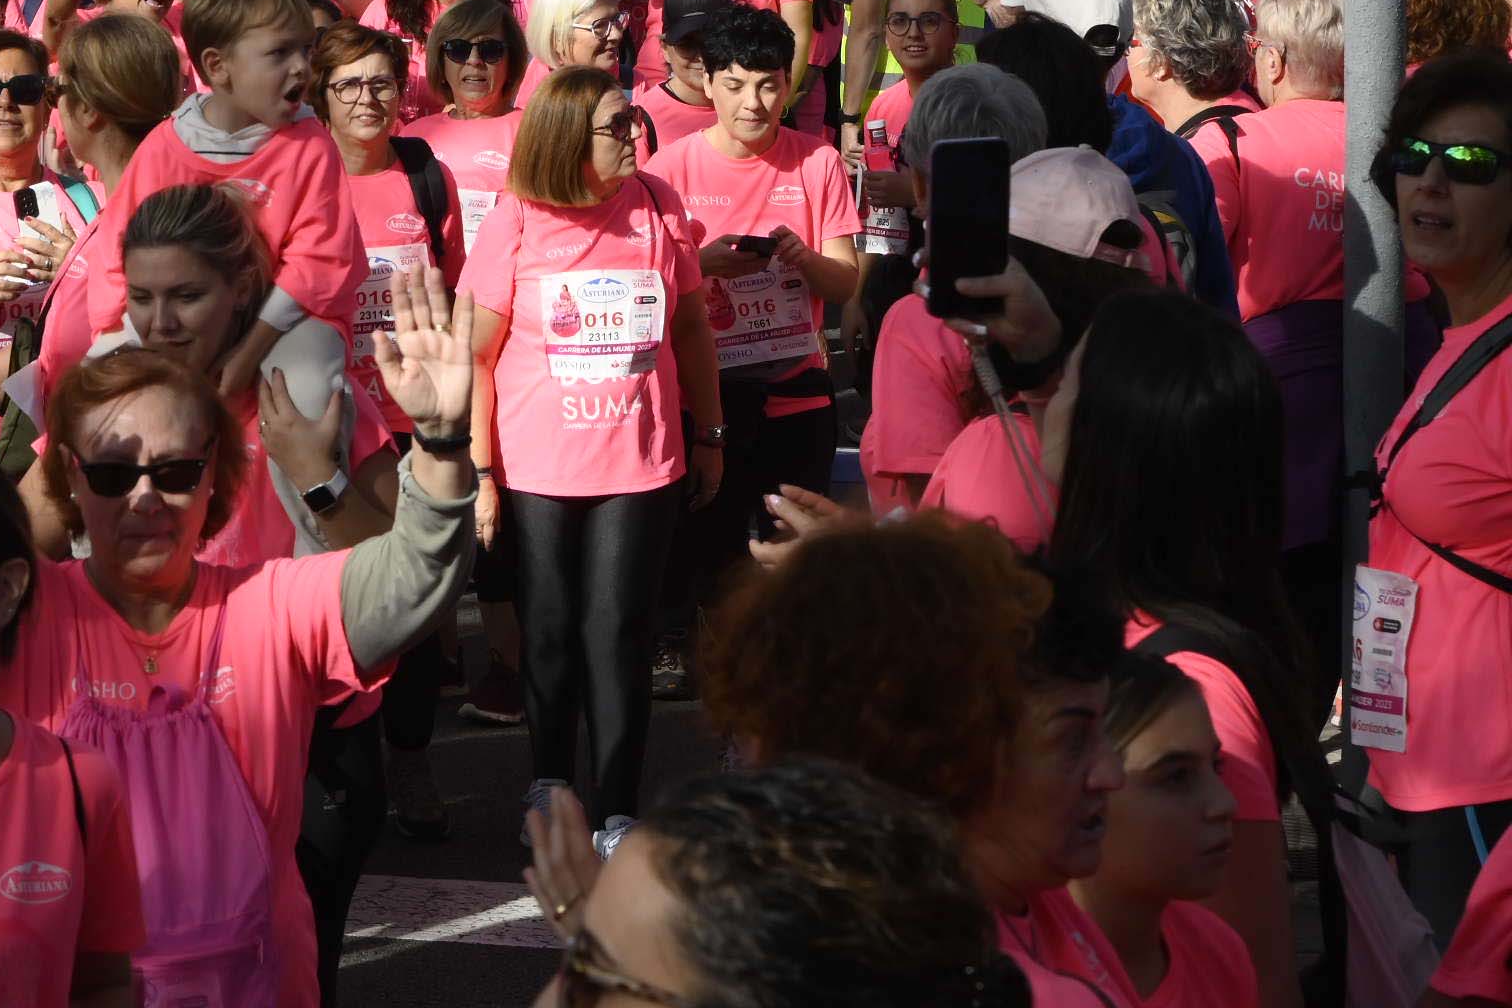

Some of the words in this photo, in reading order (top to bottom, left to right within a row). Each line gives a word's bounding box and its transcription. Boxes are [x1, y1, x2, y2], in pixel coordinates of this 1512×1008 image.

[684, 195, 731, 206] OYSHO
[632, 281, 655, 289] SUMA
[356, 290, 393, 307] 016
[581, 288, 626, 297] ASTURIANA
[738, 298, 777, 317] 016
[359, 309, 391, 321] 23114
[584, 311, 624, 328] 016
[588, 332, 620, 342] 23113
[612, 345, 636, 353] MUJER
[561, 392, 646, 421] SUMA
[1377, 595, 1406, 607] SUMA
[1357, 720, 1397, 736] Santander
[5, 874, 70, 895] ASTURIANA
